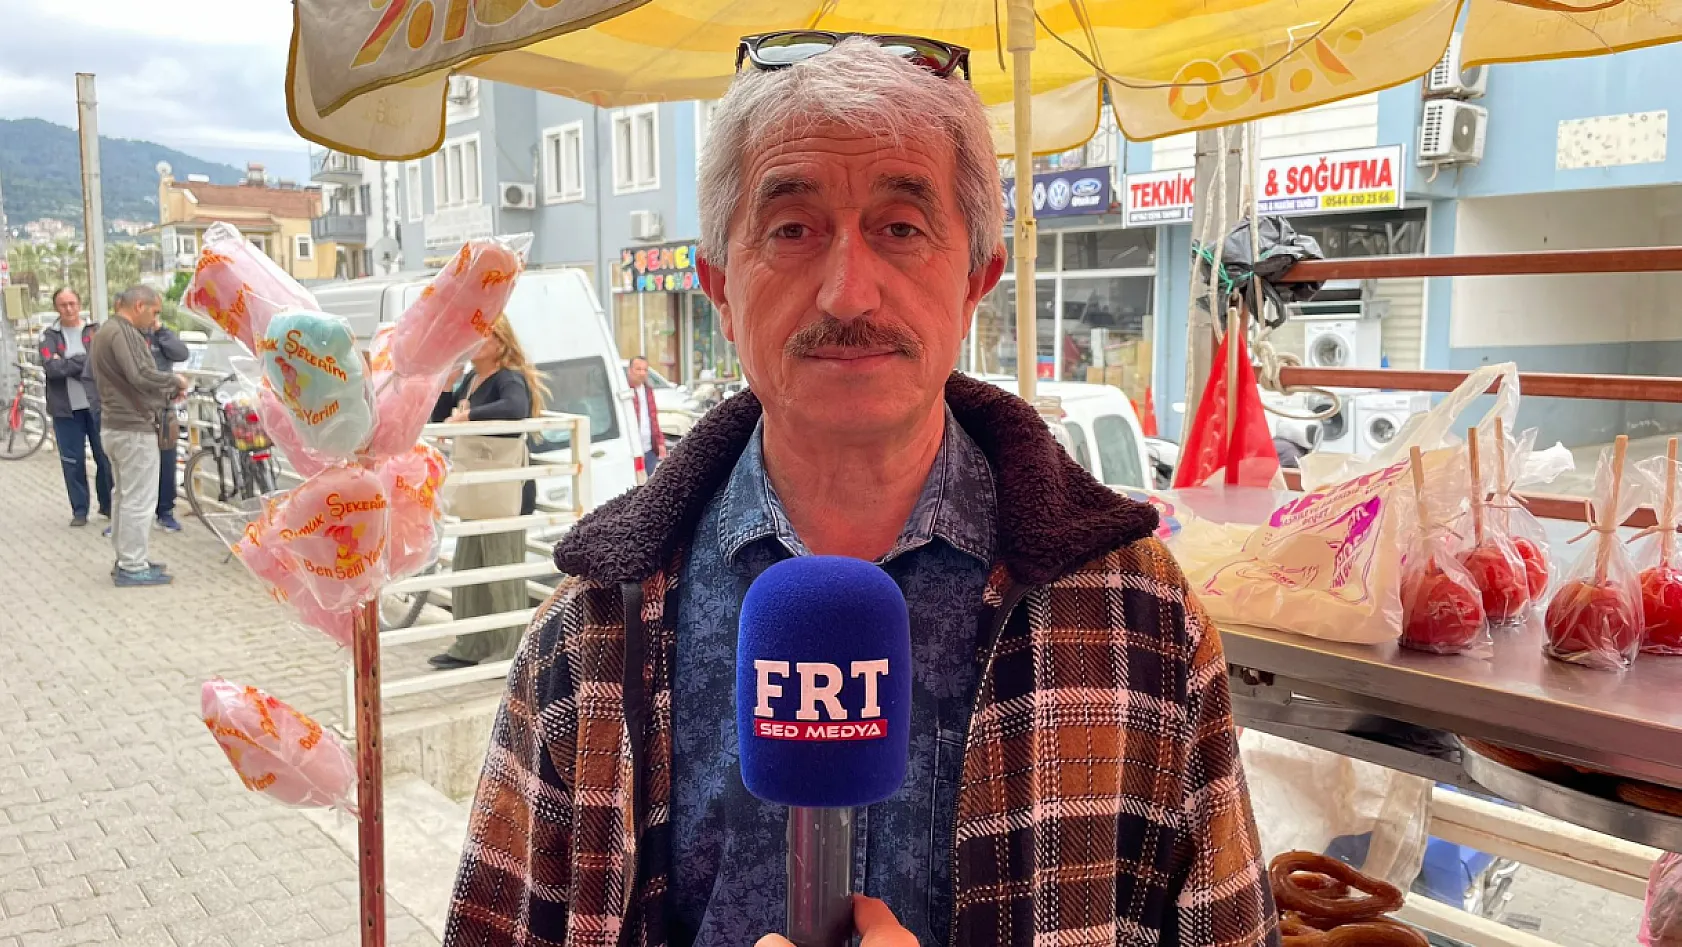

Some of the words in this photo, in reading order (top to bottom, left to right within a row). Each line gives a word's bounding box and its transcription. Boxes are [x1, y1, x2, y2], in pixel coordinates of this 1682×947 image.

[1130, 172, 1196, 208] TEKNİK
[1265, 168, 1279, 196] &
[1285, 156, 1393, 195] SOĞUTMA
[753, 659, 889, 720] FRT
[760, 723, 799, 737] SED
[804, 723, 882, 738] MEDYA
